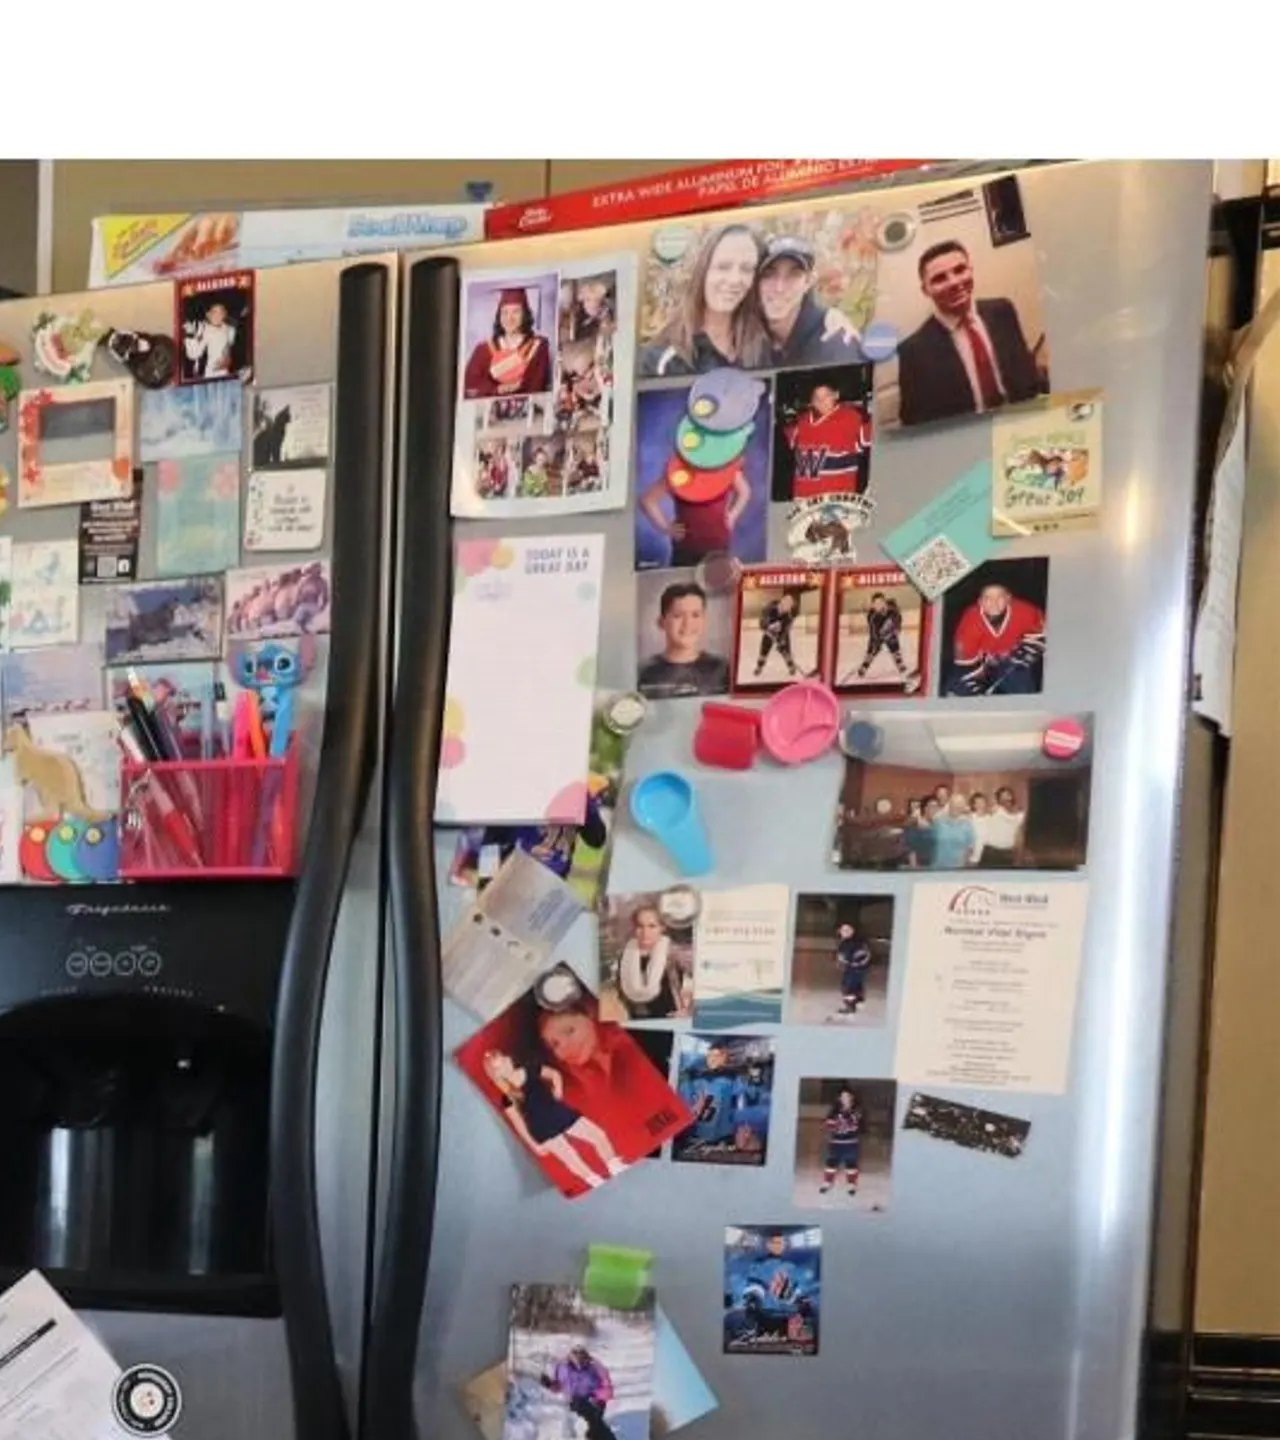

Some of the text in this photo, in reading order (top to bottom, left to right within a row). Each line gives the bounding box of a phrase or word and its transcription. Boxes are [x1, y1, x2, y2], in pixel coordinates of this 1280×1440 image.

[592, 189, 636, 209] EXTRA
[639, 182, 673, 202] WIDE
[677, 166, 754, 191] ALUMINUM
[742, 176, 760, 190] DE
[526, 547, 591, 561] TODAY IS A
[525, 560, 589, 575] GREAT DAY
[759, 573, 807, 586] ALLSTAR
